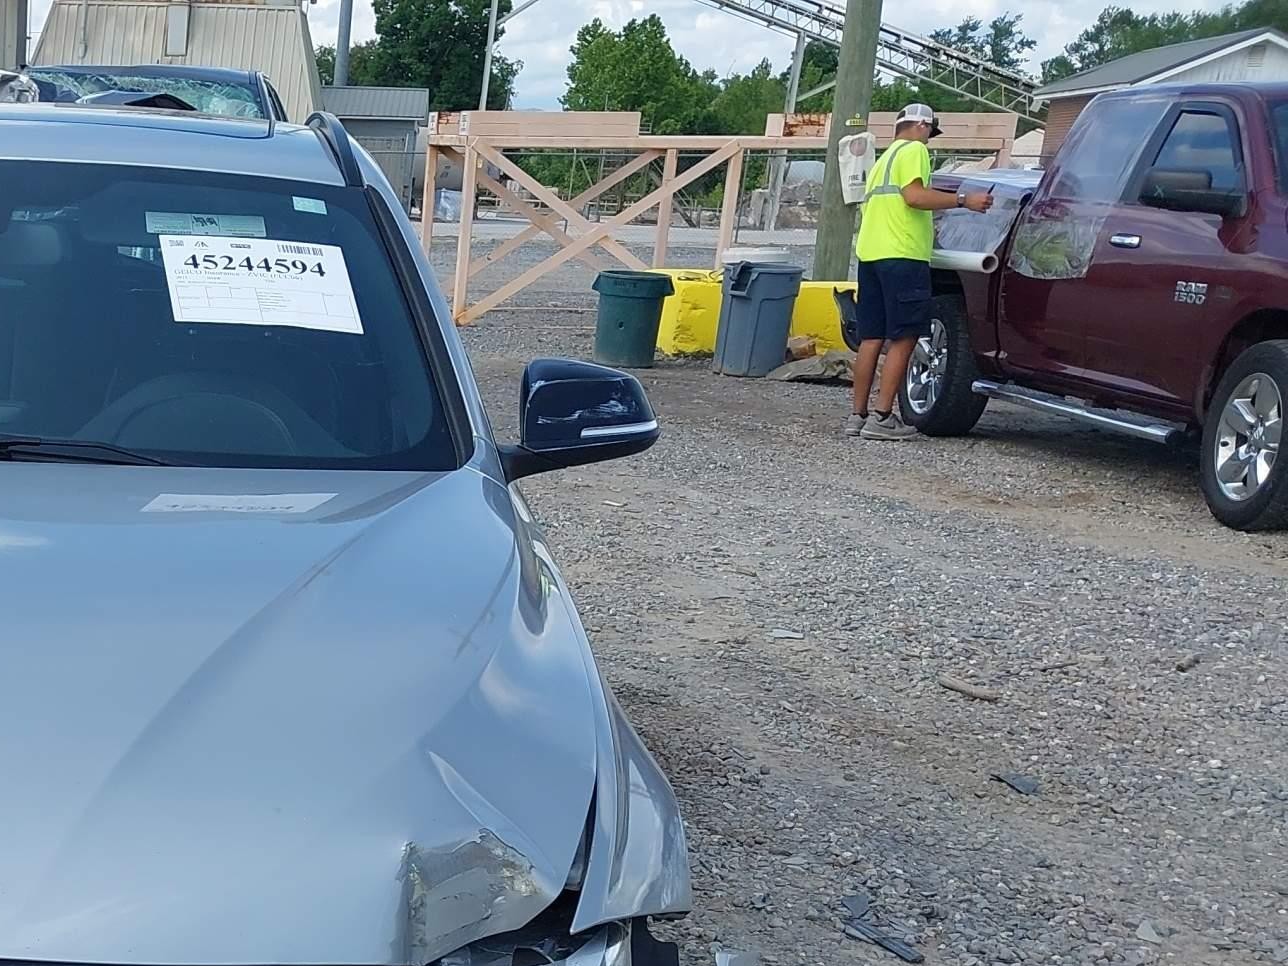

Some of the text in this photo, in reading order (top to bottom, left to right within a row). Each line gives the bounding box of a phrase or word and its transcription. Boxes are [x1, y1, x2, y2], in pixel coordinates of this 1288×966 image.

[184, 254, 326, 277] 45244594
[1176, 281, 1208, 293] RAM
[1175, 292, 1206, 304] 1500
